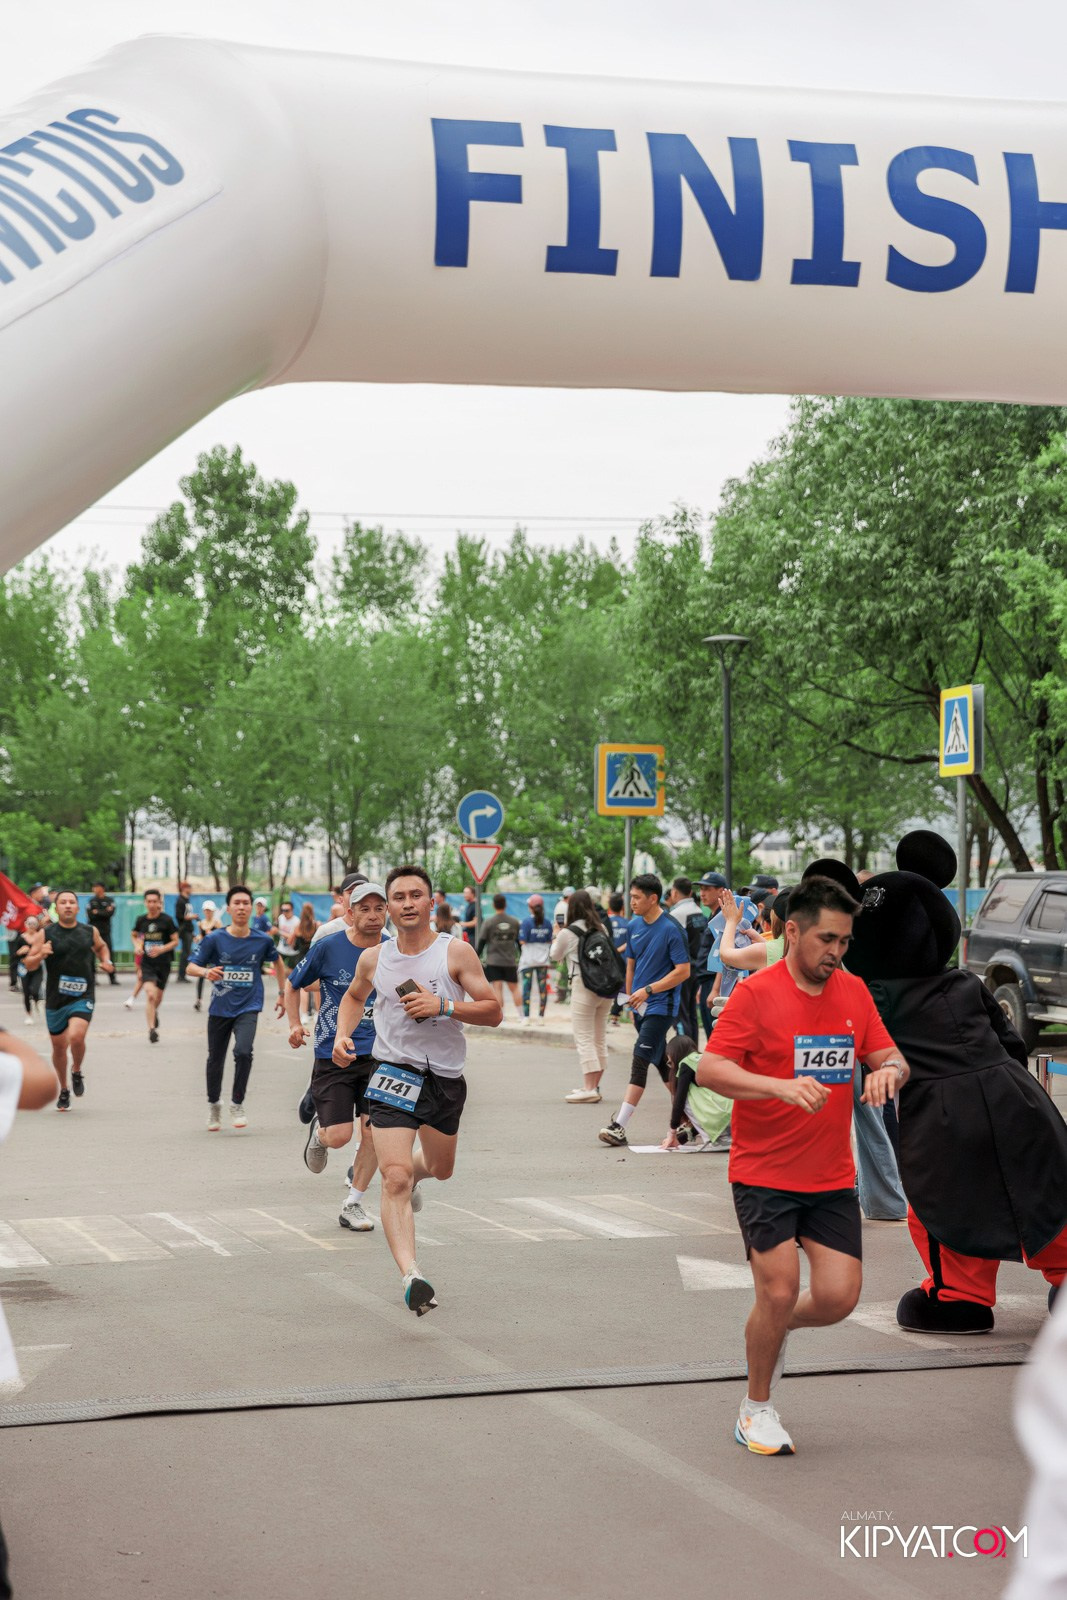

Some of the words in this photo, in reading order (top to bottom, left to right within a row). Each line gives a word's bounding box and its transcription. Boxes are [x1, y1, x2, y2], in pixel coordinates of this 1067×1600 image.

[227, 972, 250, 980] 1022
[802, 1050, 849, 1067] 1464
[377, 1076, 412, 1097] 1141
